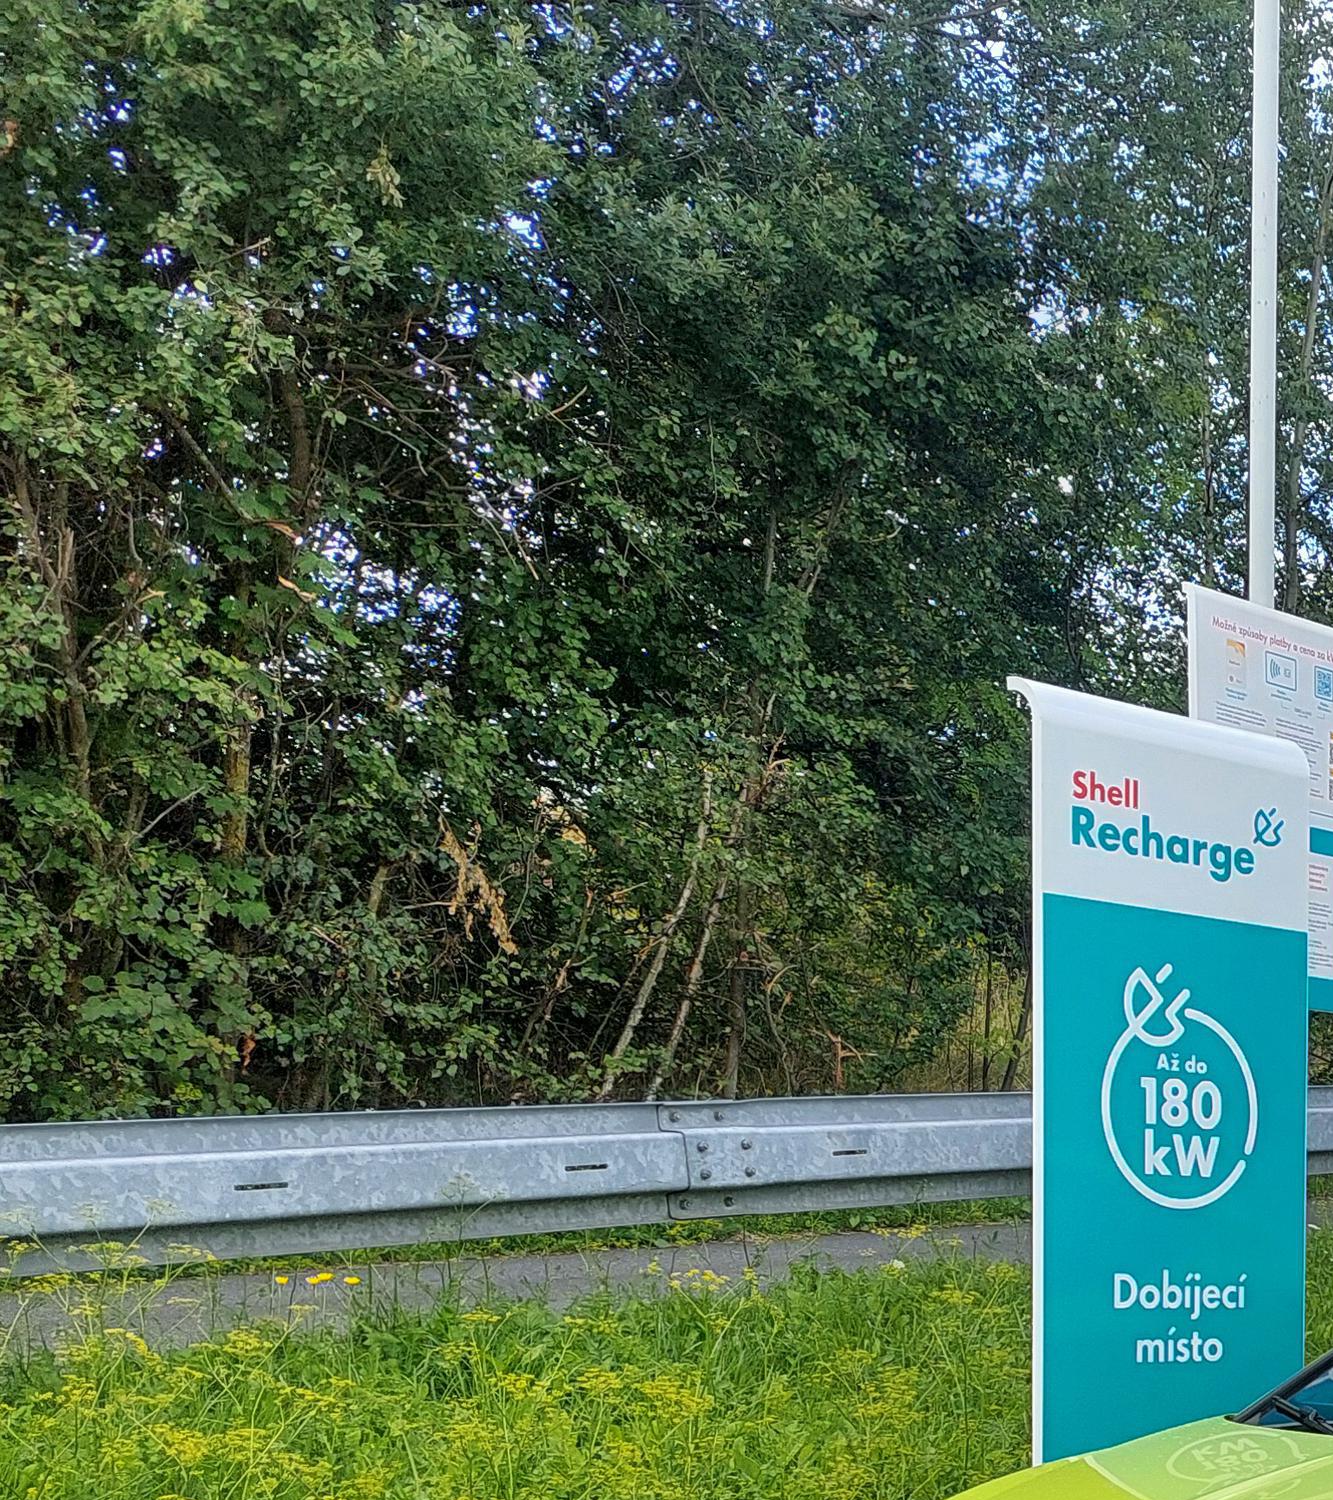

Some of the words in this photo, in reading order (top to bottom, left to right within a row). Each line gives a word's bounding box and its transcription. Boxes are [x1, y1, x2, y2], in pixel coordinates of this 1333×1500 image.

[1212, 616, 1237, 633] Možné
[1239, 625, 1268, 645] způsoby
[1269, 634, 1291, 652] platby
[1299, 646, 1316, 657] cena
[1317, 651, 1326, 660] za
[1072, 770, 1138, 809] Shell
[1071, 805, 1255, 883] Recharge
[1157, 1052, 1180, 1072] Až
[1184, 1054, 1208, 1074] do
[1140, 1076, 1222, 1130] 180
[1144, 1128, 1220, 1178] kW
[1113, 1268, 1247, 1320] Dobíjecí
[1136, 1326, 1223, 1362] místo
